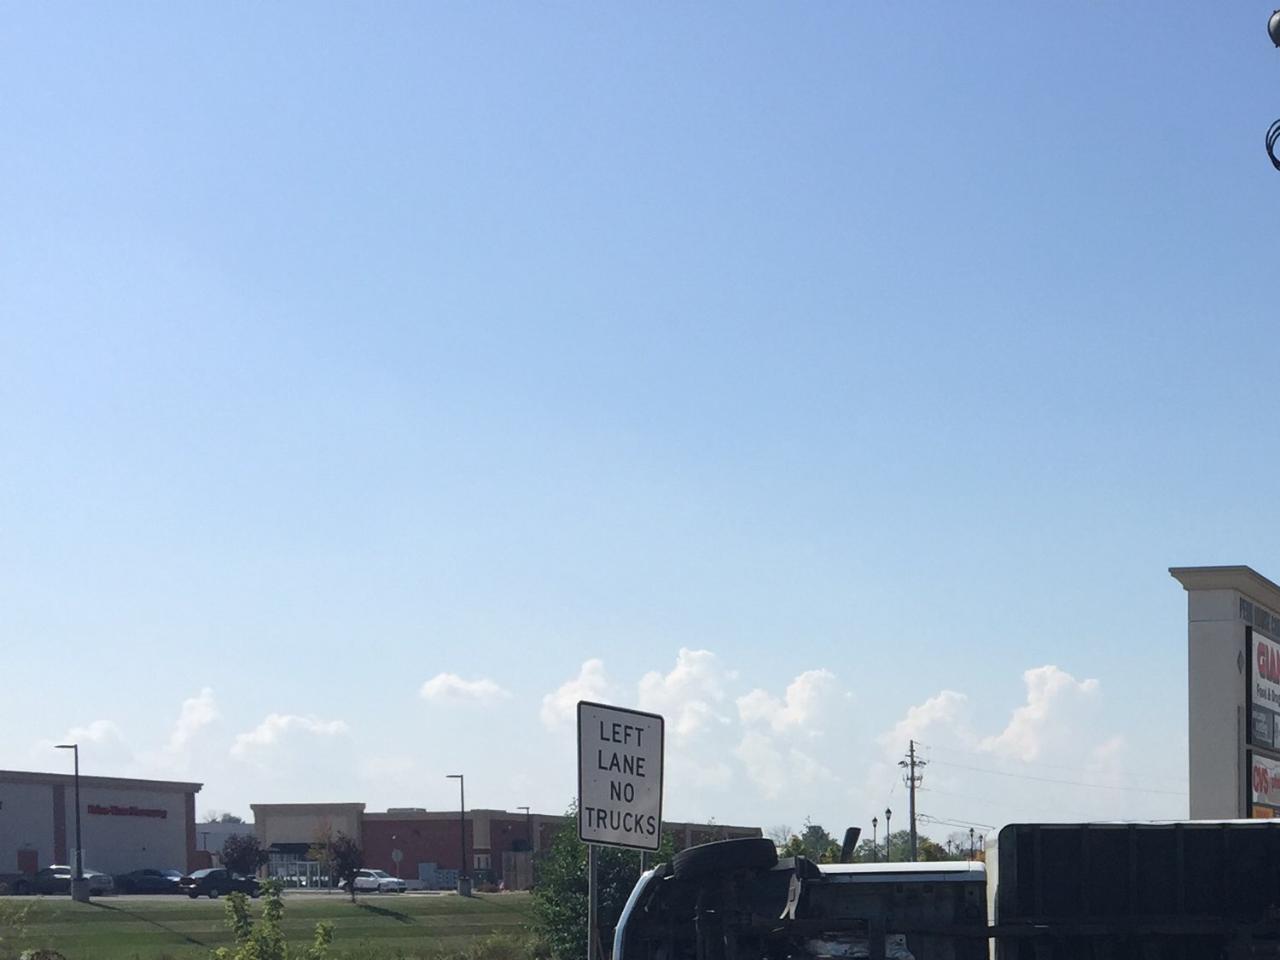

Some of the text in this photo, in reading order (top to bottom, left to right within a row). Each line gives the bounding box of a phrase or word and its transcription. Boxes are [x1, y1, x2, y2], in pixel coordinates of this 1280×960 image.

[600, 721, 644, 747] LEFT
[598, 749, 646, 777] LANE
[611, 781, 634, 803] NO
[1253, 766, 1269, 795] CVS
[585, 807, 656, 835] TRUCKS
